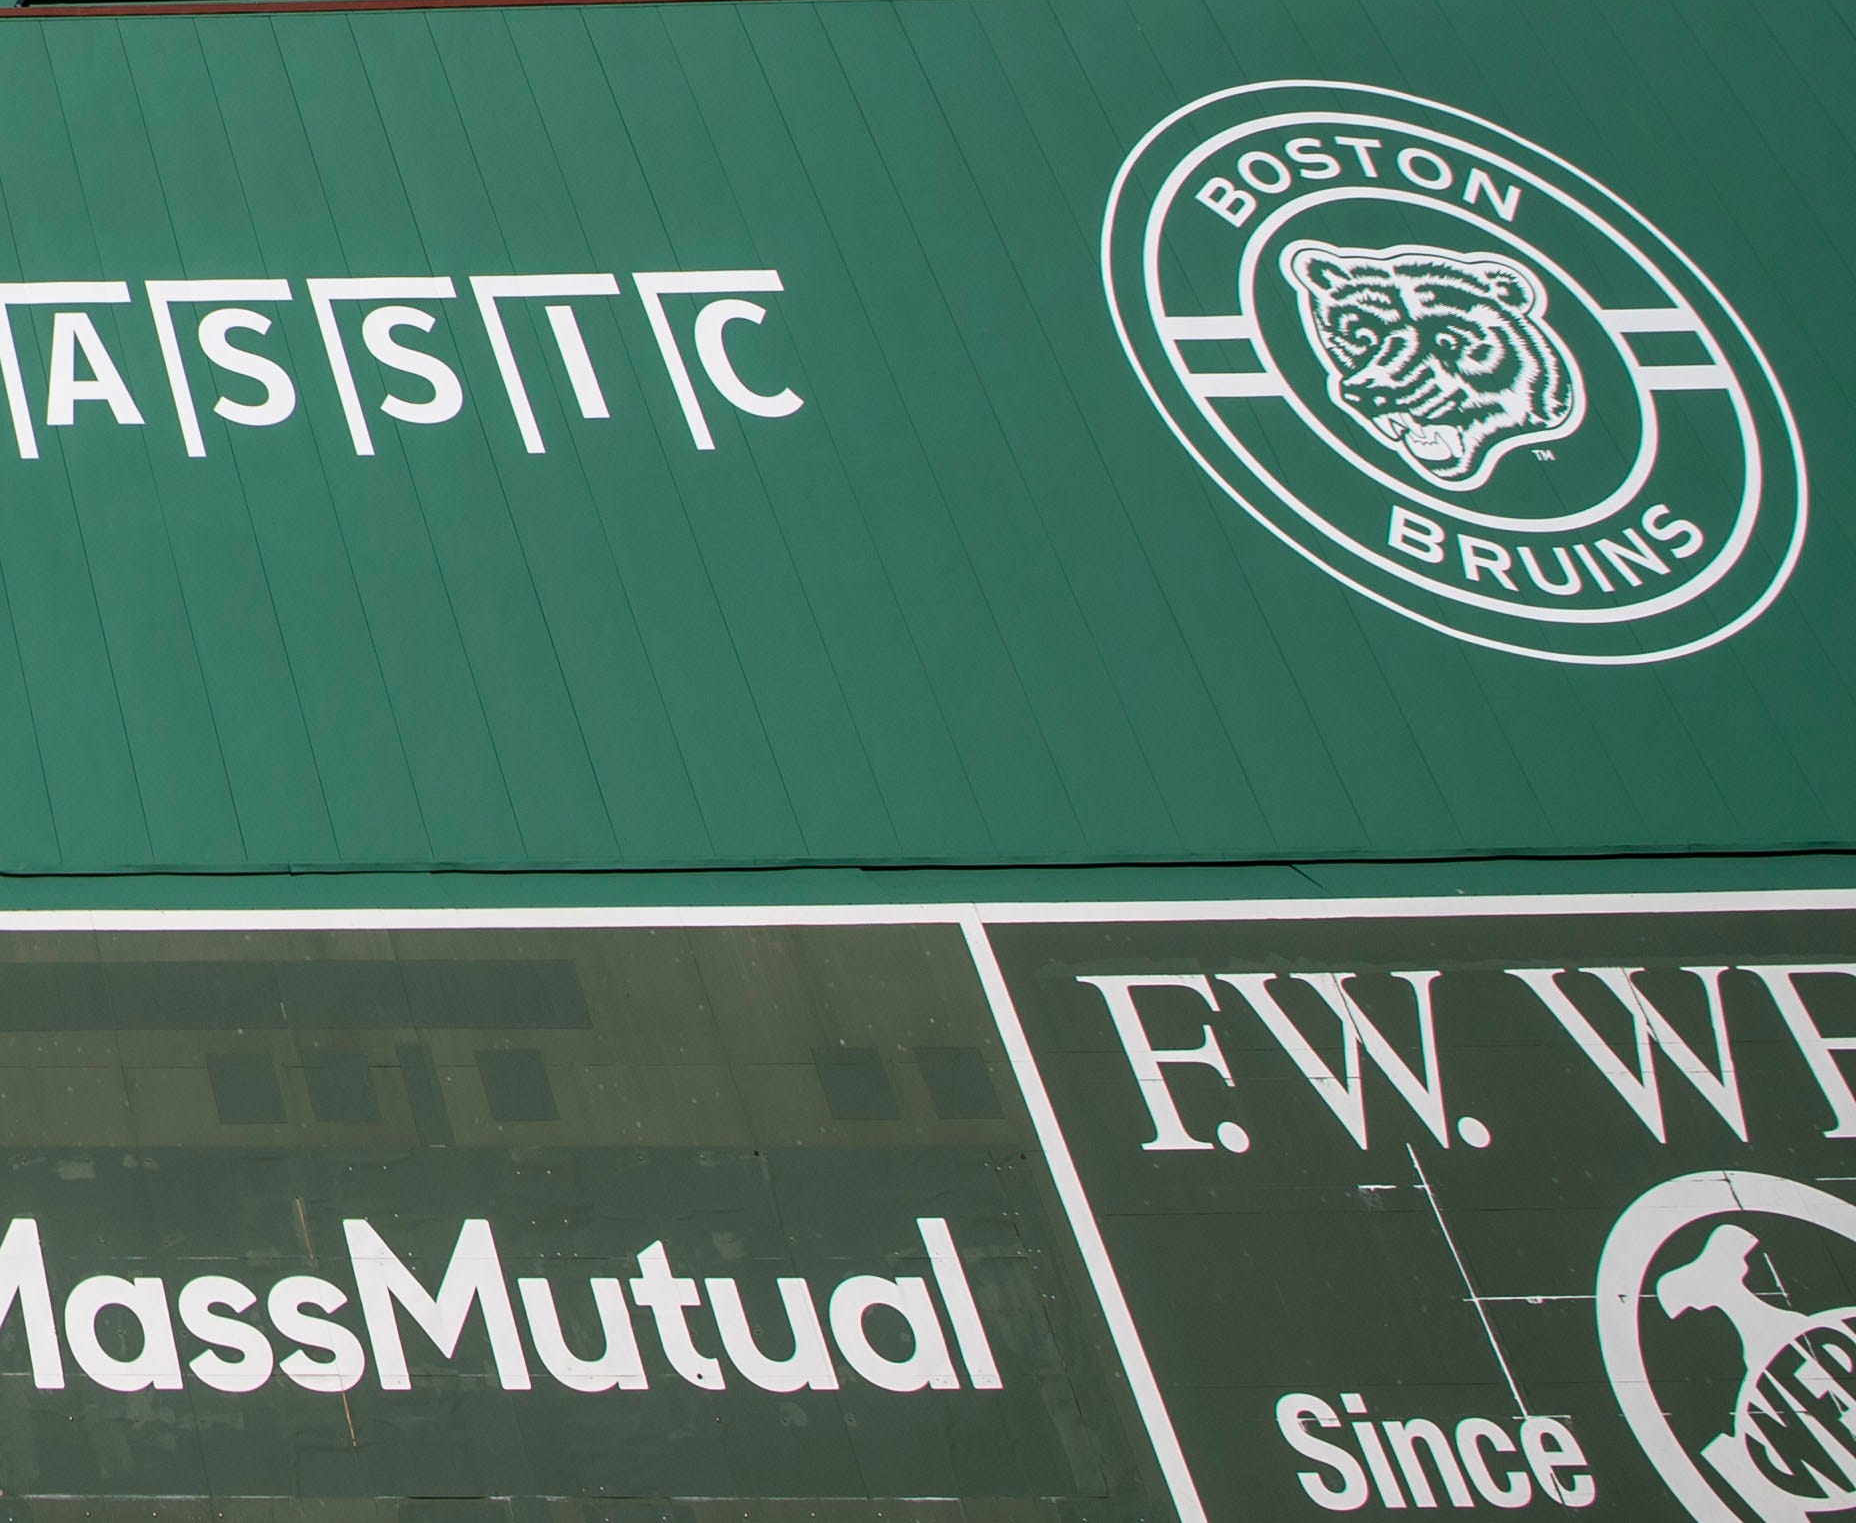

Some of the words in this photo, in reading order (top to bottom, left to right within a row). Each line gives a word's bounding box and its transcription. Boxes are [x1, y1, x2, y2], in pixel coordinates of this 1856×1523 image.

[1195, 135, 1522, 228] BOSTON
[1387, 503, 1705, 597] BRUINS
[1275, 1392, 1596, 1512] Since
